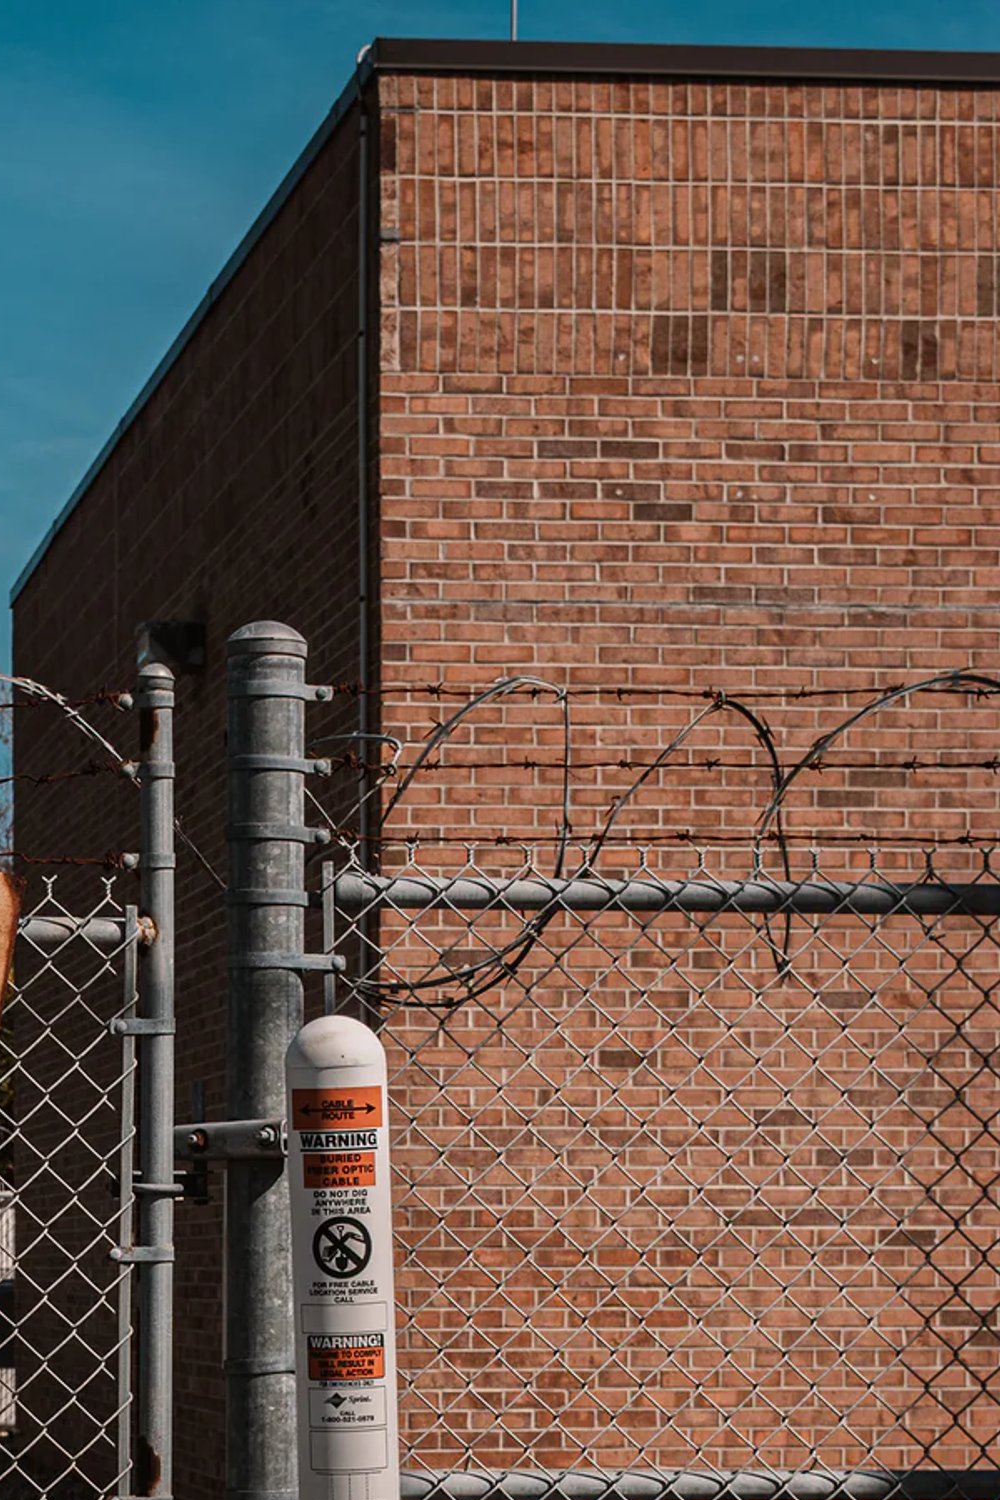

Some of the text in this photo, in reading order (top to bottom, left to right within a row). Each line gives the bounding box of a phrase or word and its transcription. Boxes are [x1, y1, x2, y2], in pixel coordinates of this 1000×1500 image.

[321, 1099, 354, 1108] CABLE
[321, 1111, 355, 1120] ROUTE
[300, 1132, 377, 1148] WARNING
[320, 1153, 361, 1164] BURIED
[341, 1164, 374, 1174] OPTIC
[323, 1177, 359, 1187] CABLE
[313, 1189, 368, 1198] DO NOT DIG
[315, 1198, 367, 1207] ANYWHERE
[311, 1207, 371, 1216] IN THIS AREA
[309, 1287, 378, 1296] LOCATION SERVICE
[310, 1334, 381, 1349] WARNING!
[354, 1350, 381, 1358] COMPLY
[337, 1360, 365, 1368] RESULT
[346, 1368, 374, 1377] ACTION
